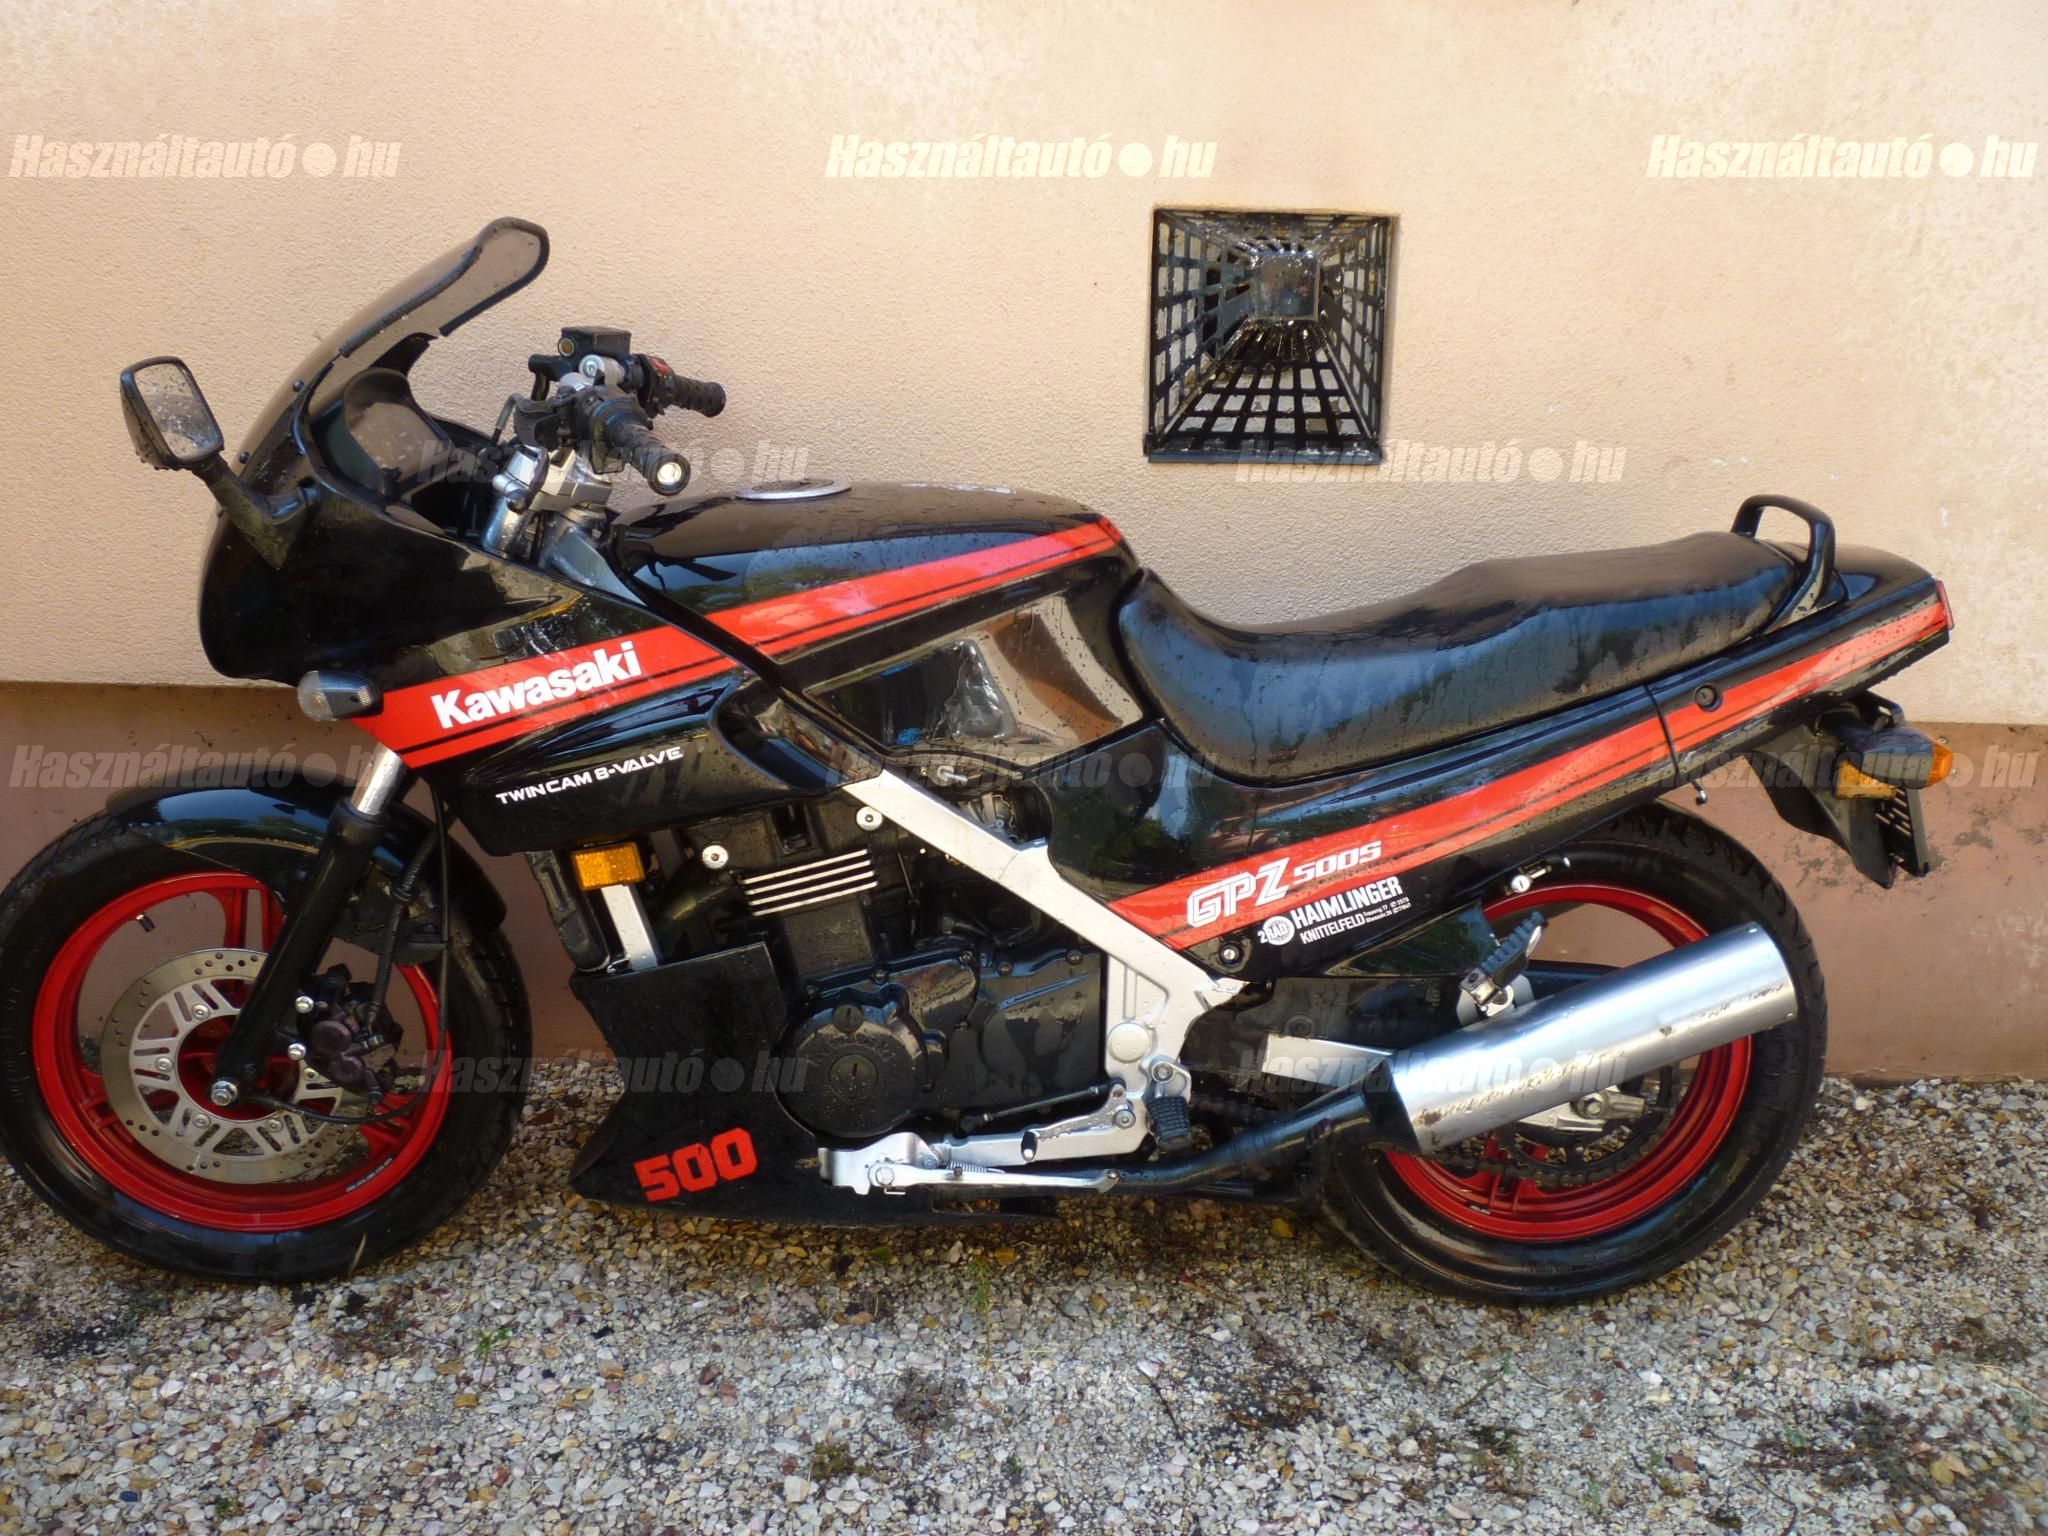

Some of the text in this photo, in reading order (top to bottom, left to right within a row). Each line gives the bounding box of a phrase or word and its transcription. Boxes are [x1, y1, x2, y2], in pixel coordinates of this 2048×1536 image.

[431, 641, 642, 729] Kawasaki
[595, 746, 684, 781] 8-VALVE
[1187, 840, 1382, 928] GPZ 500S
[1290, 876, 1403, 929] HAIMLINGER
[1300, 913, 1365, 945] KNITTELFELD
[633, 1127, 758, 1203] 500
